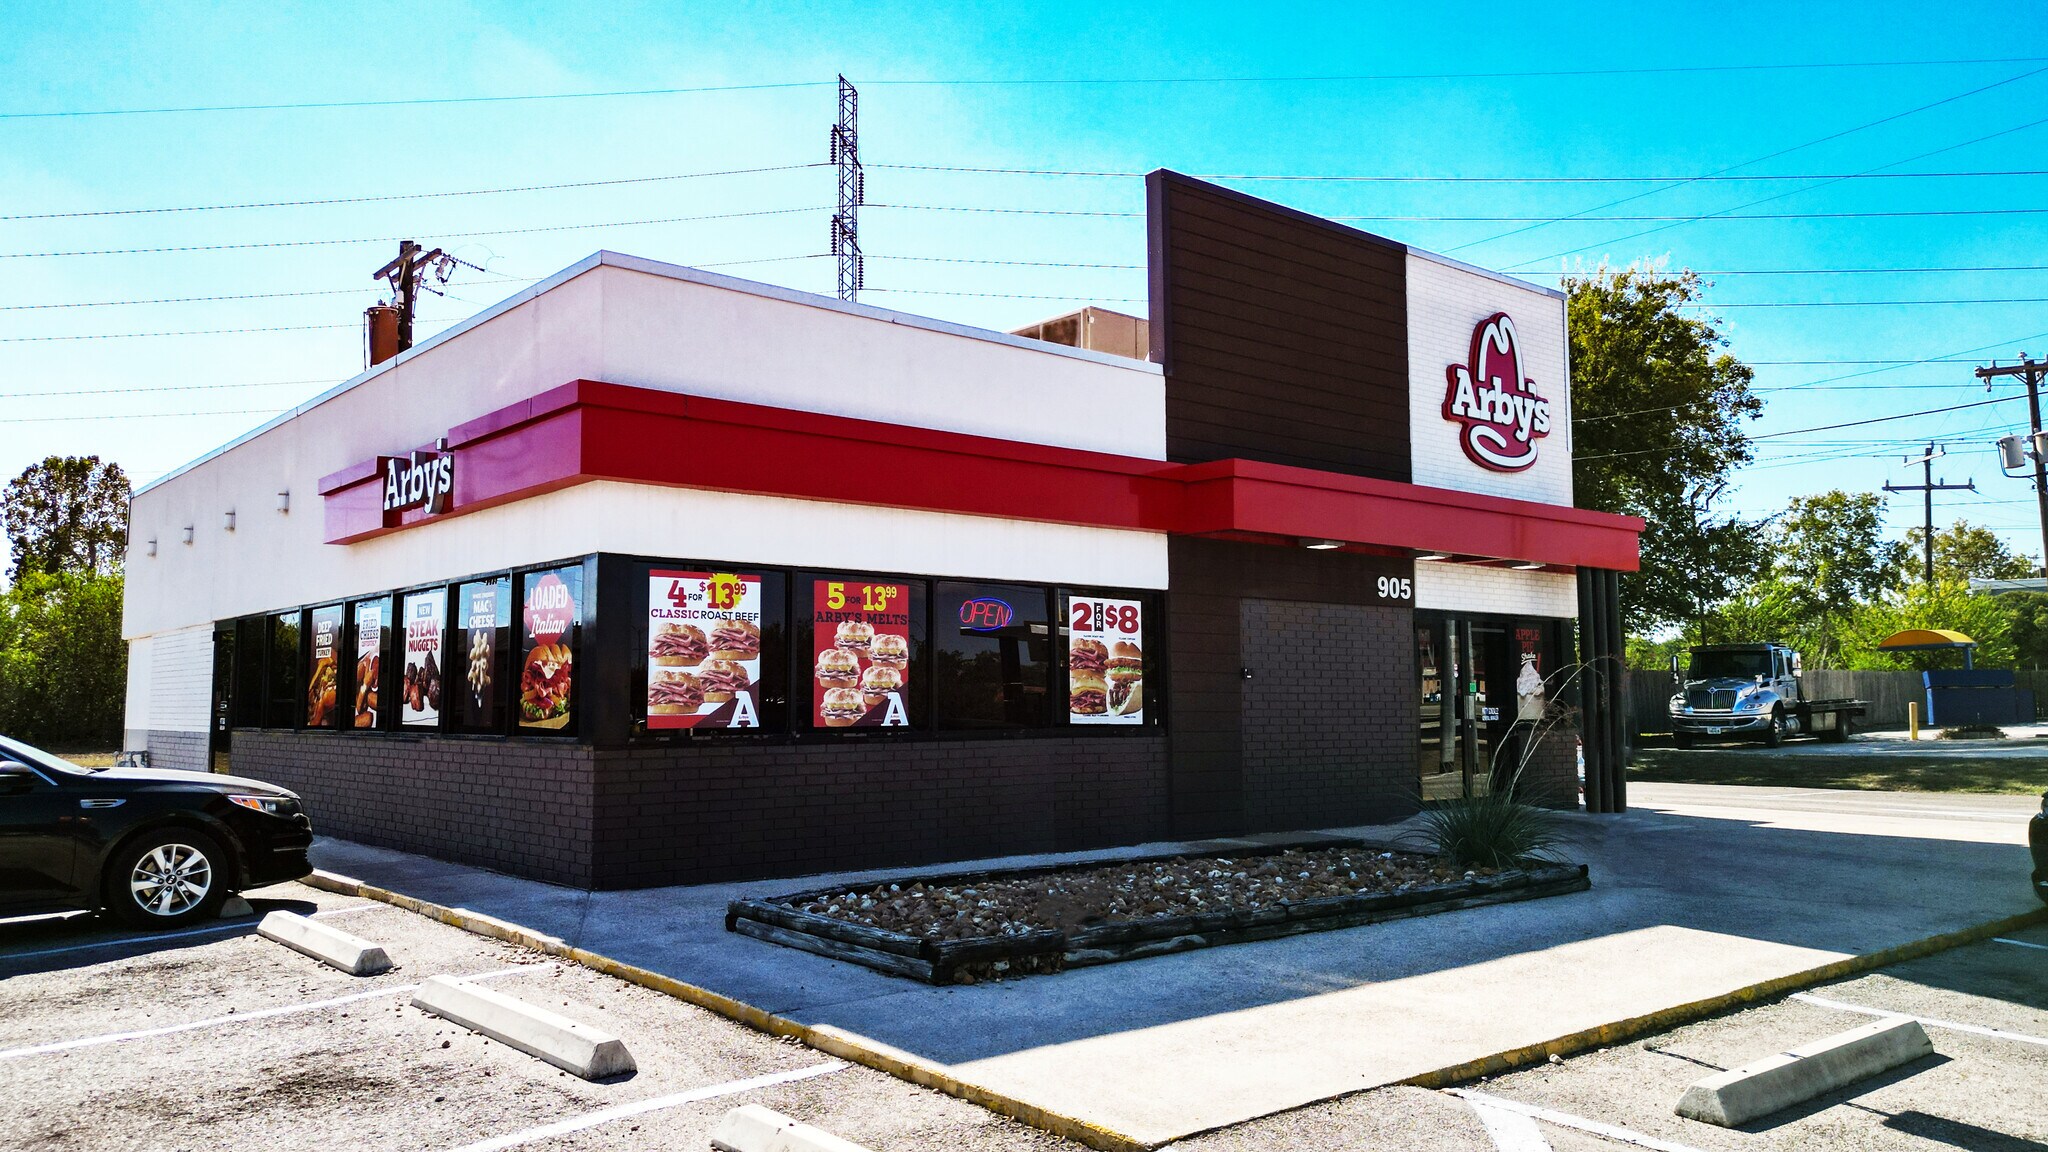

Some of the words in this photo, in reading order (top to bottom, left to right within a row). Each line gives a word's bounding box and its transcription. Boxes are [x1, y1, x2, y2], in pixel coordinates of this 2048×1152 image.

[1452, 368, 1550, 442] Arby's
[384, 437, 451, 513] Arby's
[530, 584, 567, 611] LOADED
[667, 580, 687, 608] 4
[688, 593, 702, 601] FOR
[827, 582, 846, 610] 5
[846, 596, 861, 604] FOR
[1377, 576, 1411, 600] 905
[418, 604, 431, 616] NEW
[651, 608, 699, 619] CLASSIC
[701, 611, 733, 620] ROAST
[735, 612, 759, 622] BEEF
[816, 611, 862, 623] ARBY'S
[867, 613, 907, 625] MELTS
[960, 600, 1010, 627] OPEN
[1072, 602, 1092, 631] 2
[1105, 604, 1139, 634] $8
[317, 620, 332, 634] DEEP
[409, 619, 438, 638] STEAK
[469, 614, 495, 628] CHEESE
[529, 613, 566, 638] Italian
[315, 633, 332, 647] FRIED
[1515, 628, 1540, 640] APPLE
[409, 638, 438, 652] NUGGETS
[1521, 641, 1534, 652] PIE
